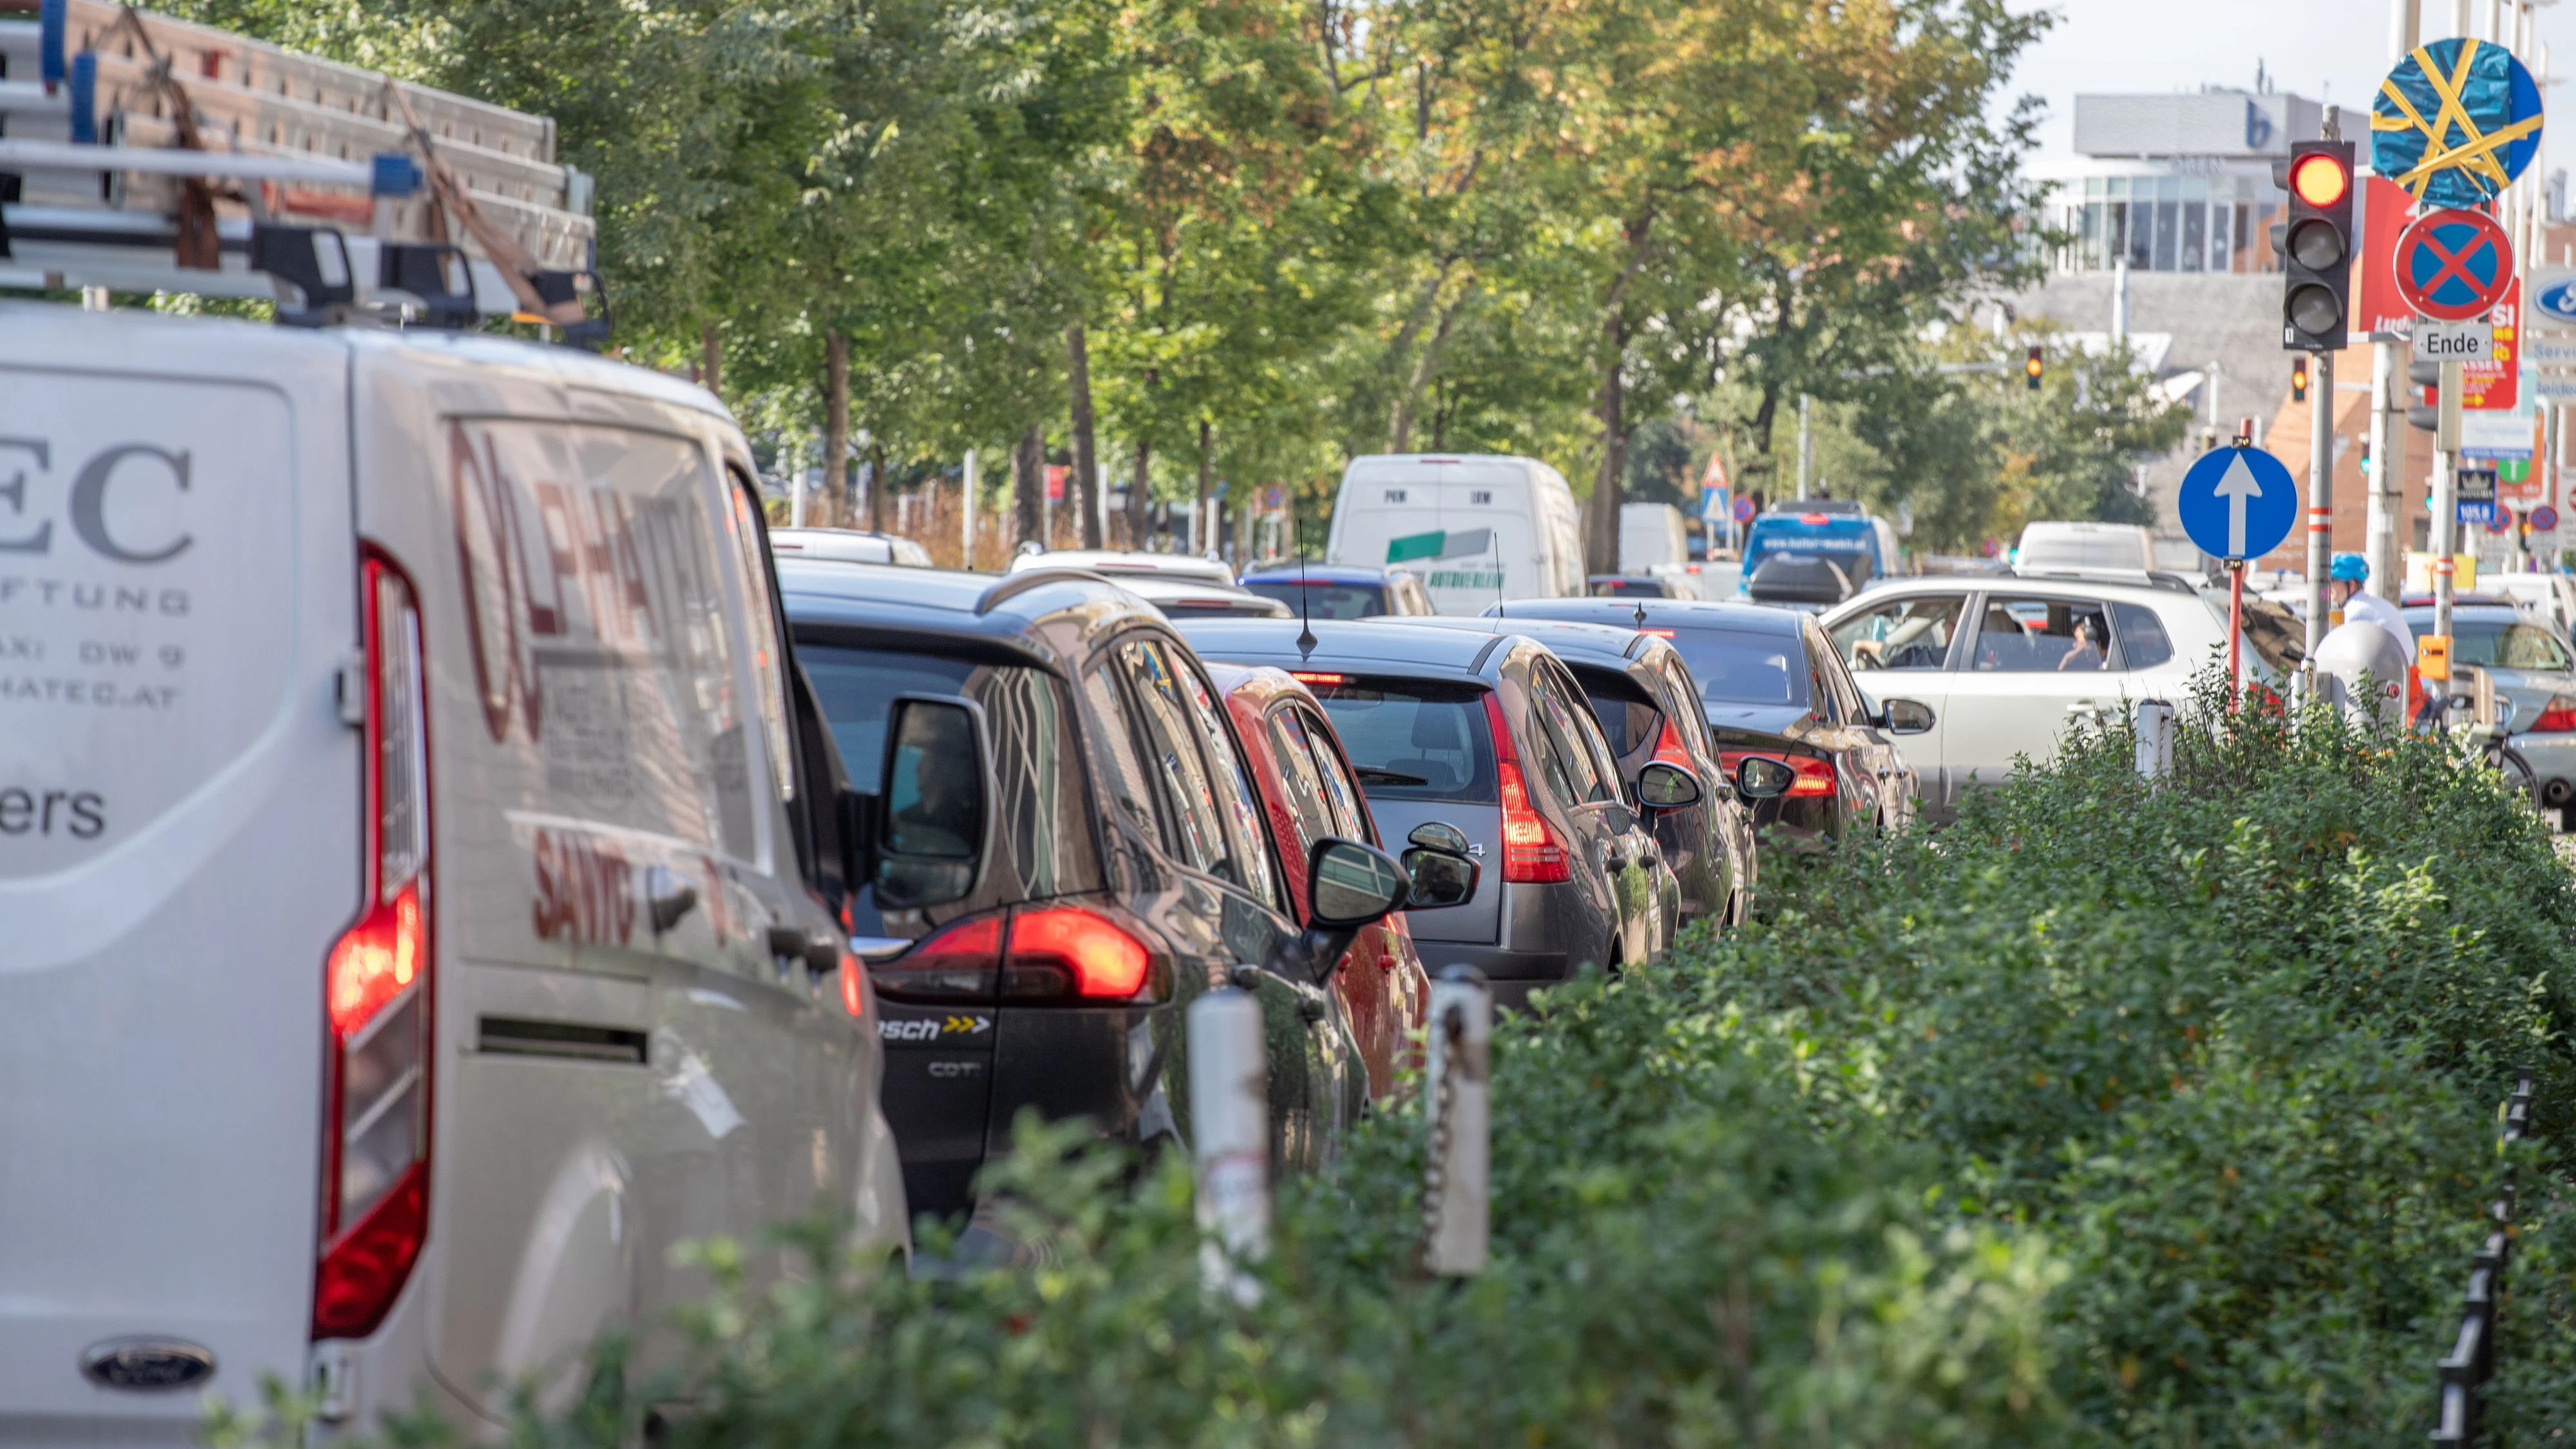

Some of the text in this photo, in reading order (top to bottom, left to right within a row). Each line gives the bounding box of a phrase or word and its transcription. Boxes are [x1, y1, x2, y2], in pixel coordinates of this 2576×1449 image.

[2427, 333, 2478, 354] Ende
[0, 436, 195, 567] EC
[79, 639, 142, 666] DW
[0, 787, 106, 840] ers
[1469, 843, 1486, 857] 4
